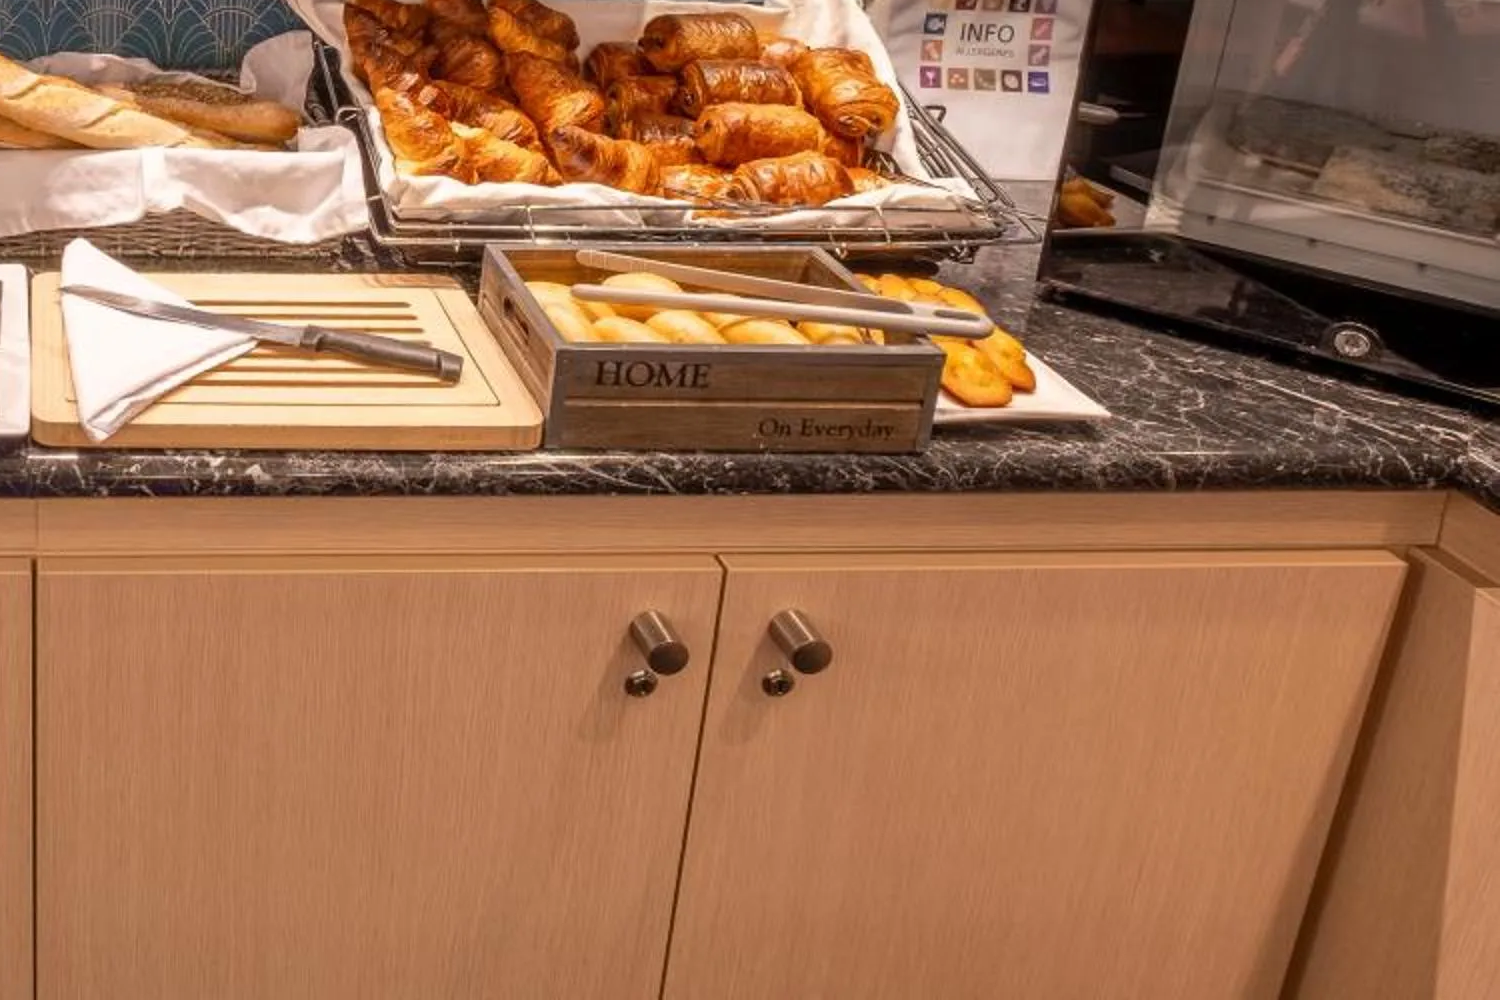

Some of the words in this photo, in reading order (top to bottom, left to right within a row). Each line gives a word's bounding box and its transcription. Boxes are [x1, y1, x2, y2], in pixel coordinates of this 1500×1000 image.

[959, 23, 1015, 44] INFO
[595, 360, 712, 389] HOME
[757, 417, 791, 438] On
[799, 416, 896, 441] Everyday
